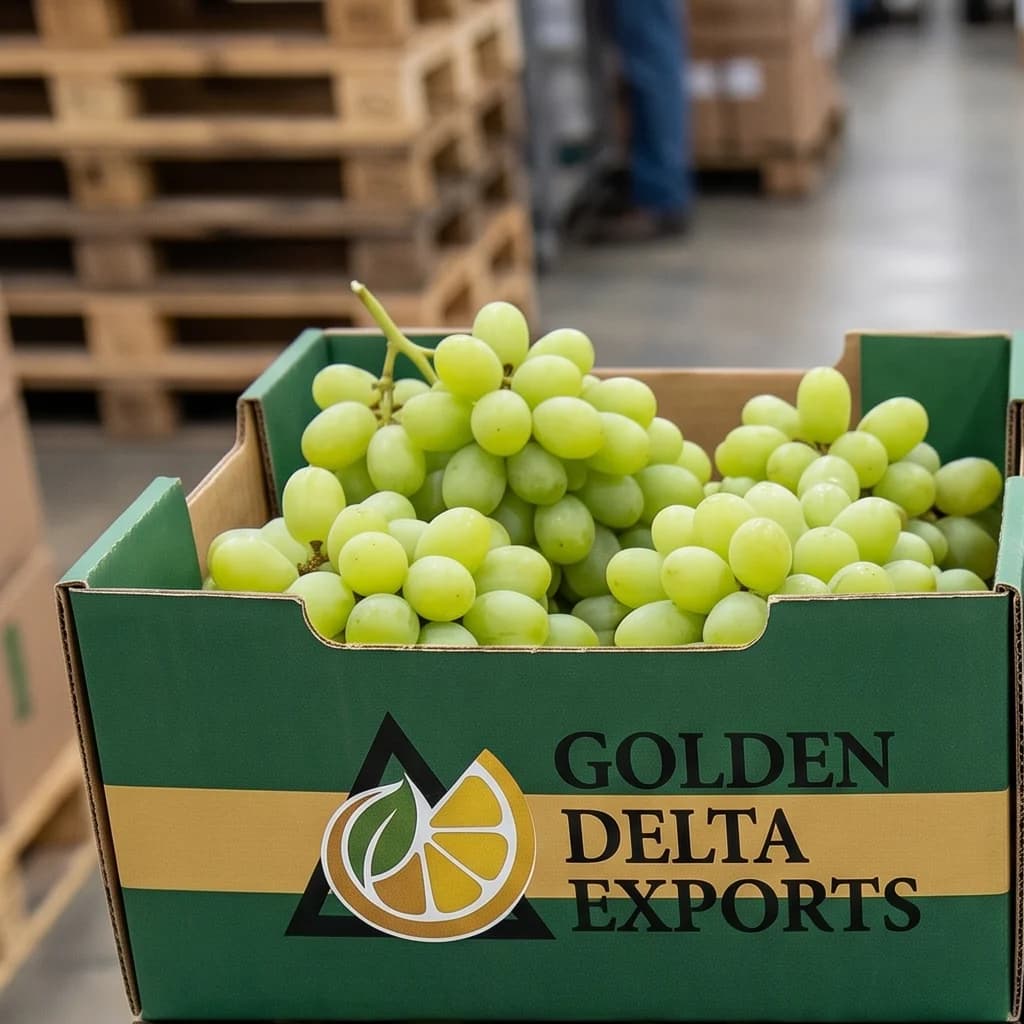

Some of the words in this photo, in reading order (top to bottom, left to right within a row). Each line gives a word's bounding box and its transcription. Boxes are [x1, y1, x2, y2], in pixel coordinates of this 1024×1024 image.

[553, 730, 896, 790] GOLDEN
[562, 808, 810, 864] DELTA
[568, 877, 922, 934] EXPORTS
